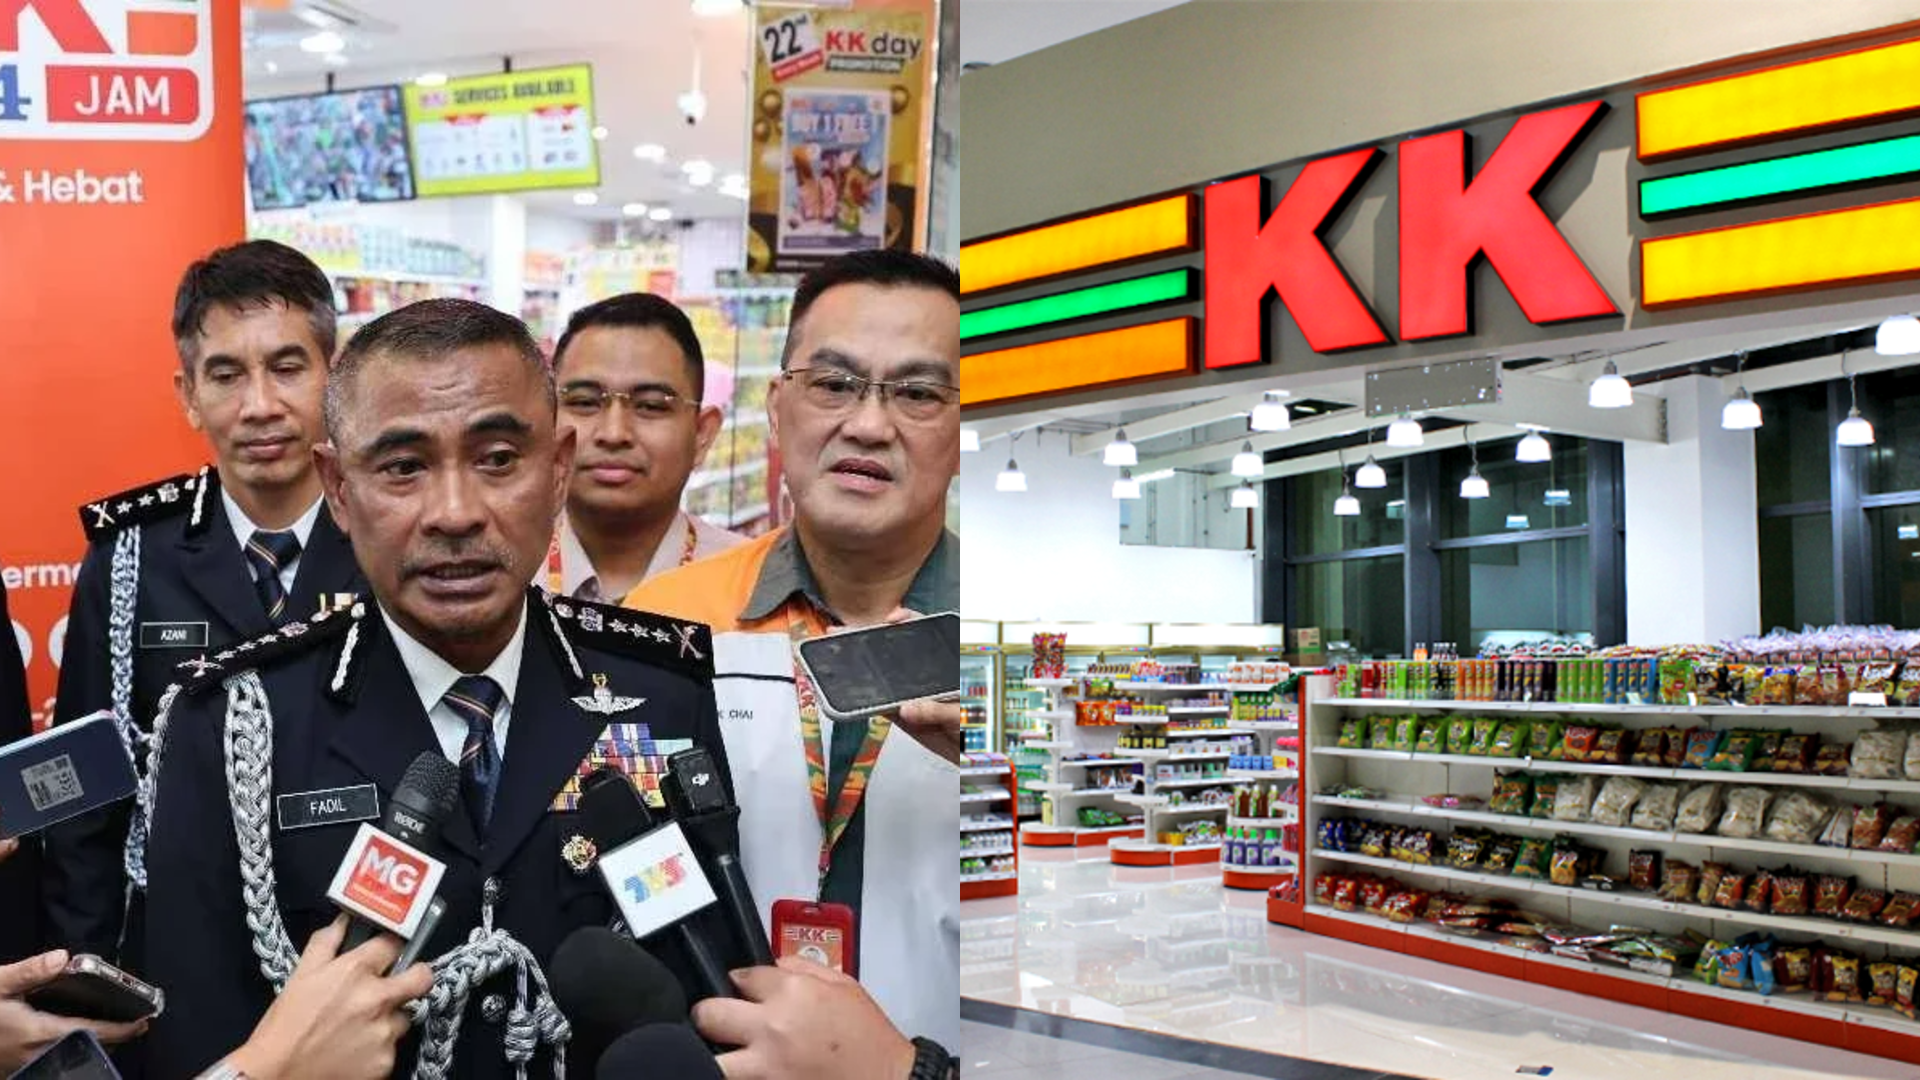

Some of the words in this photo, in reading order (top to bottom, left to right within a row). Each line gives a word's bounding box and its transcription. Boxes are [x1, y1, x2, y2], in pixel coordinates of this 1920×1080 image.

[825, 31, 866, 52] KK
[871, 32, 922, 59] day
[75, 75, 171, 116] JAM
[24, 169, 144, 203] Hebat
[1203, 99, 1622, 370] KK
[160, 629, 187, 641] AZANI
[310, 798, 347, 816] FADIL
[359, 846, 420, 896] MG
